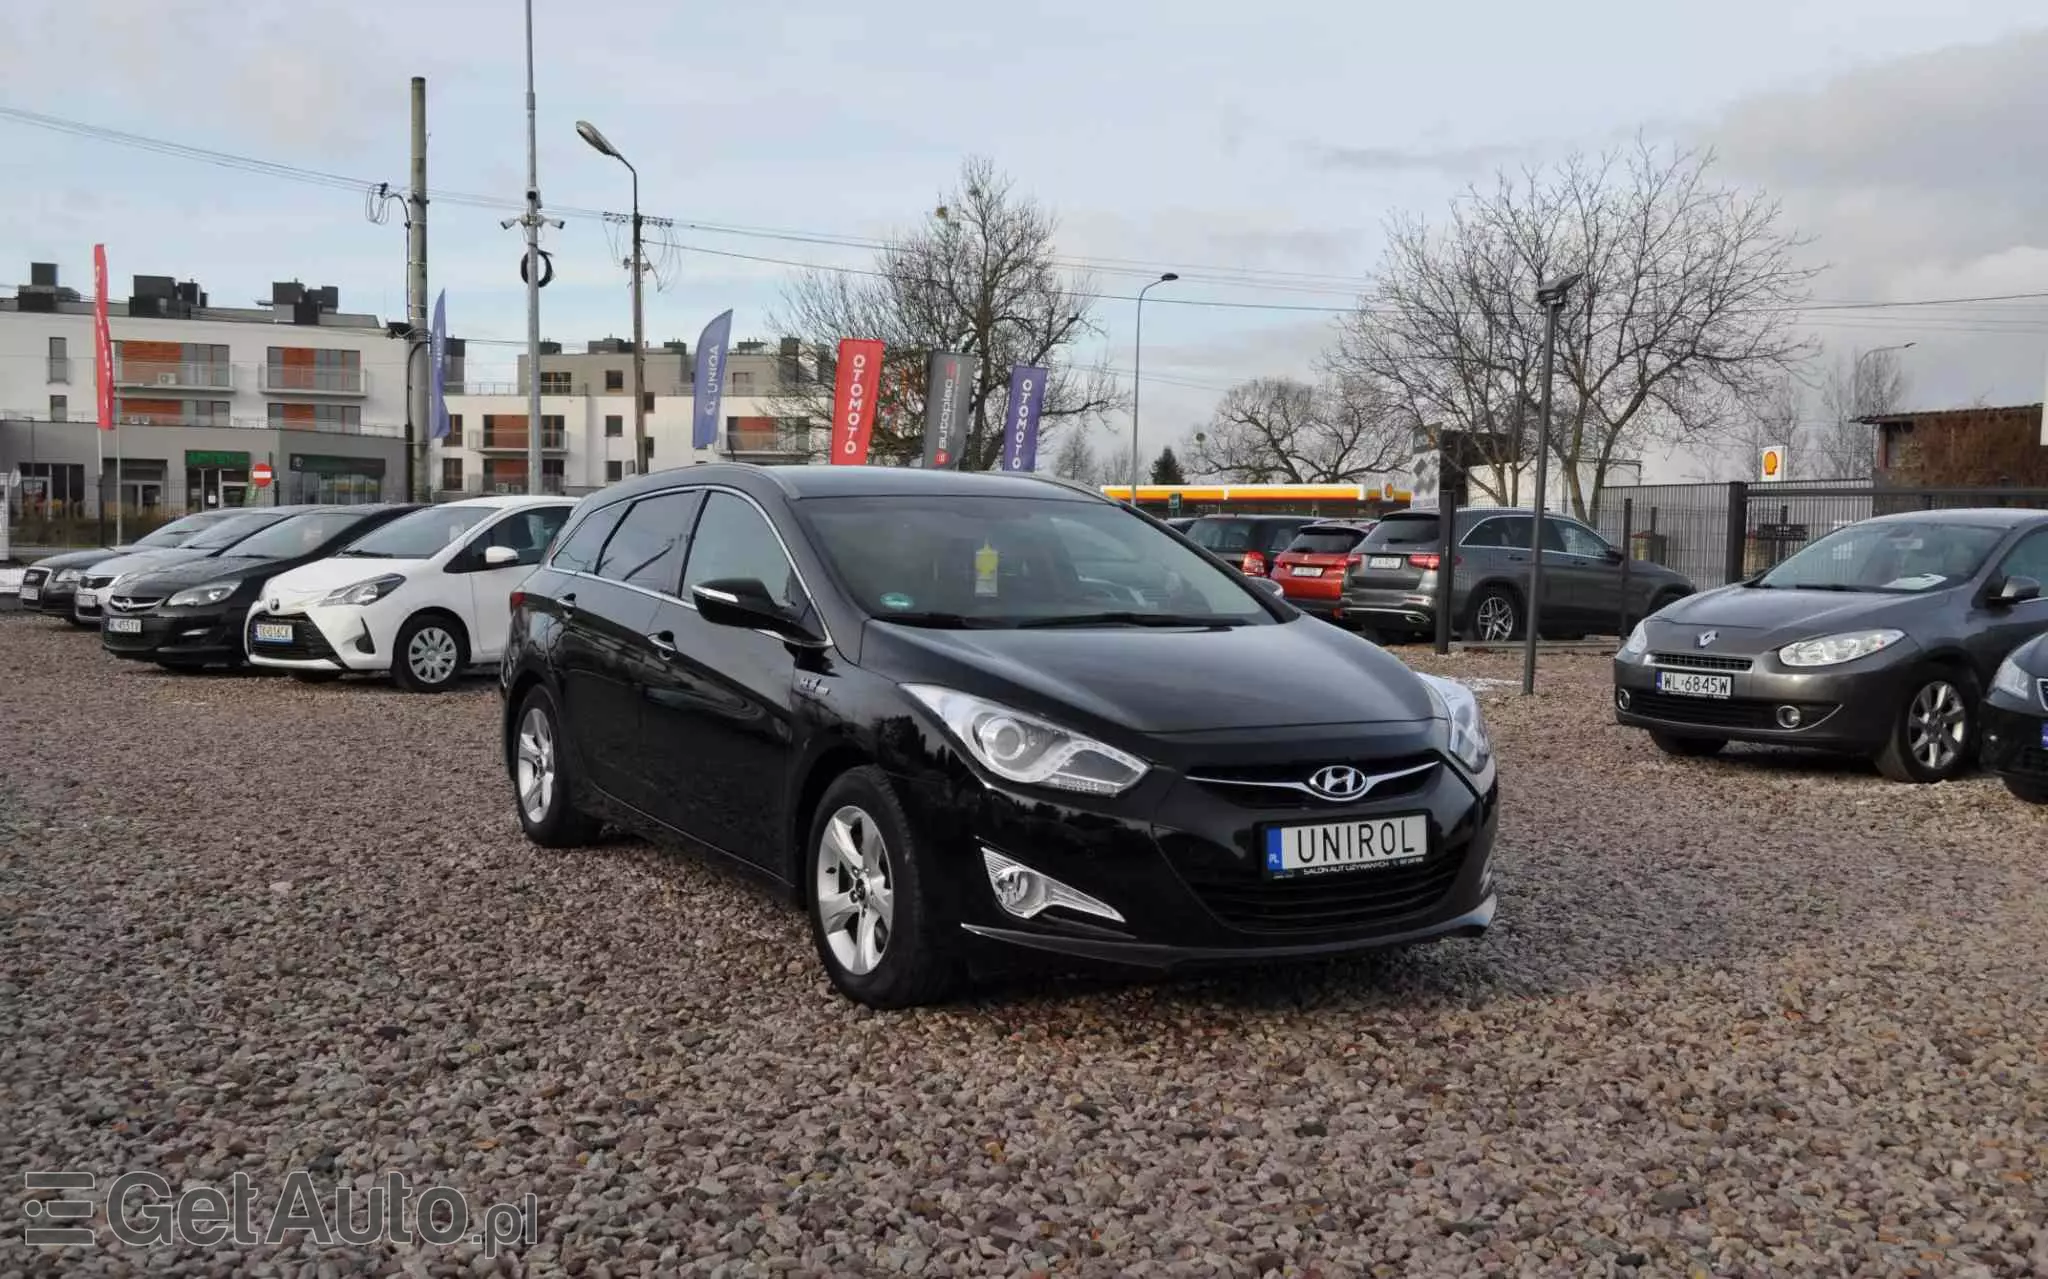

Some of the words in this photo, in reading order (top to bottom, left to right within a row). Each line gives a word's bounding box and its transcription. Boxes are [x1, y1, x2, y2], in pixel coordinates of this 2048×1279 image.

[707, 344, 720, 396] UNIQA
[845, 354, 866, 454] OTOMOTO
[1012, 379, 1033, 469] OTOMOTO
[1298, 820, 1415, 864] UNIROL
